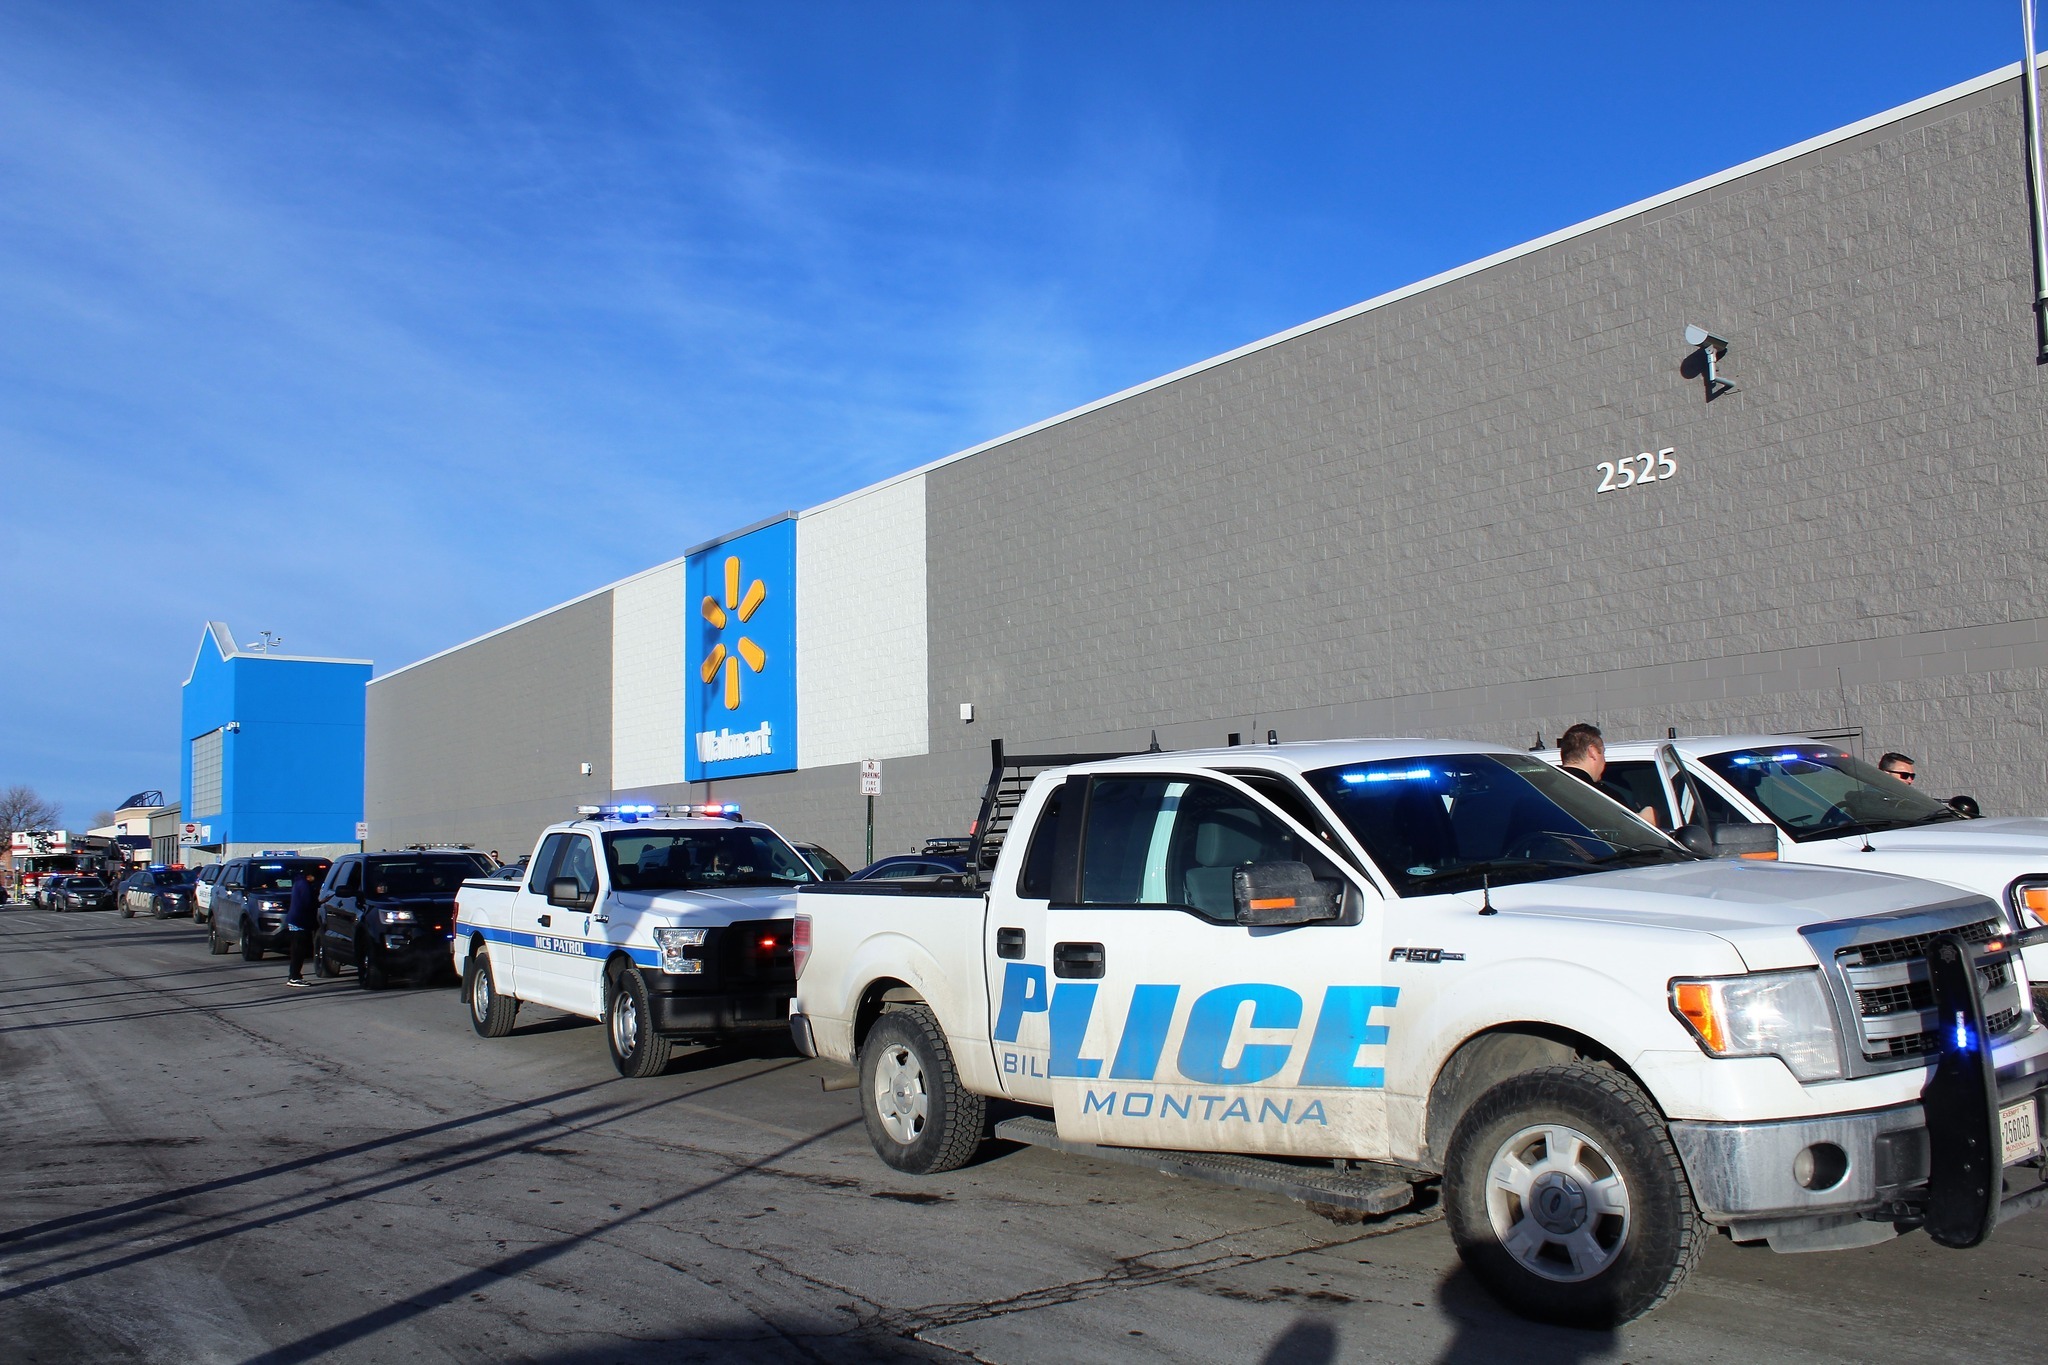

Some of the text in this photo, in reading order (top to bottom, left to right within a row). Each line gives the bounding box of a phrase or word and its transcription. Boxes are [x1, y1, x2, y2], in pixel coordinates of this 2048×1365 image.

[1596, 447, 1677, 494] 2525
[696, 720, 772, 763] Walmart
[862, 771, 881, 779] PARKING
[867, 761, 875, 771] NO
[126, 890, 152, 909] POLICE
[535, 935, 587, 956] MCS PATROL
[994, 962, 1401, 1088] PLICE
[1083, 1090, 1328, 1126] MONTANA
